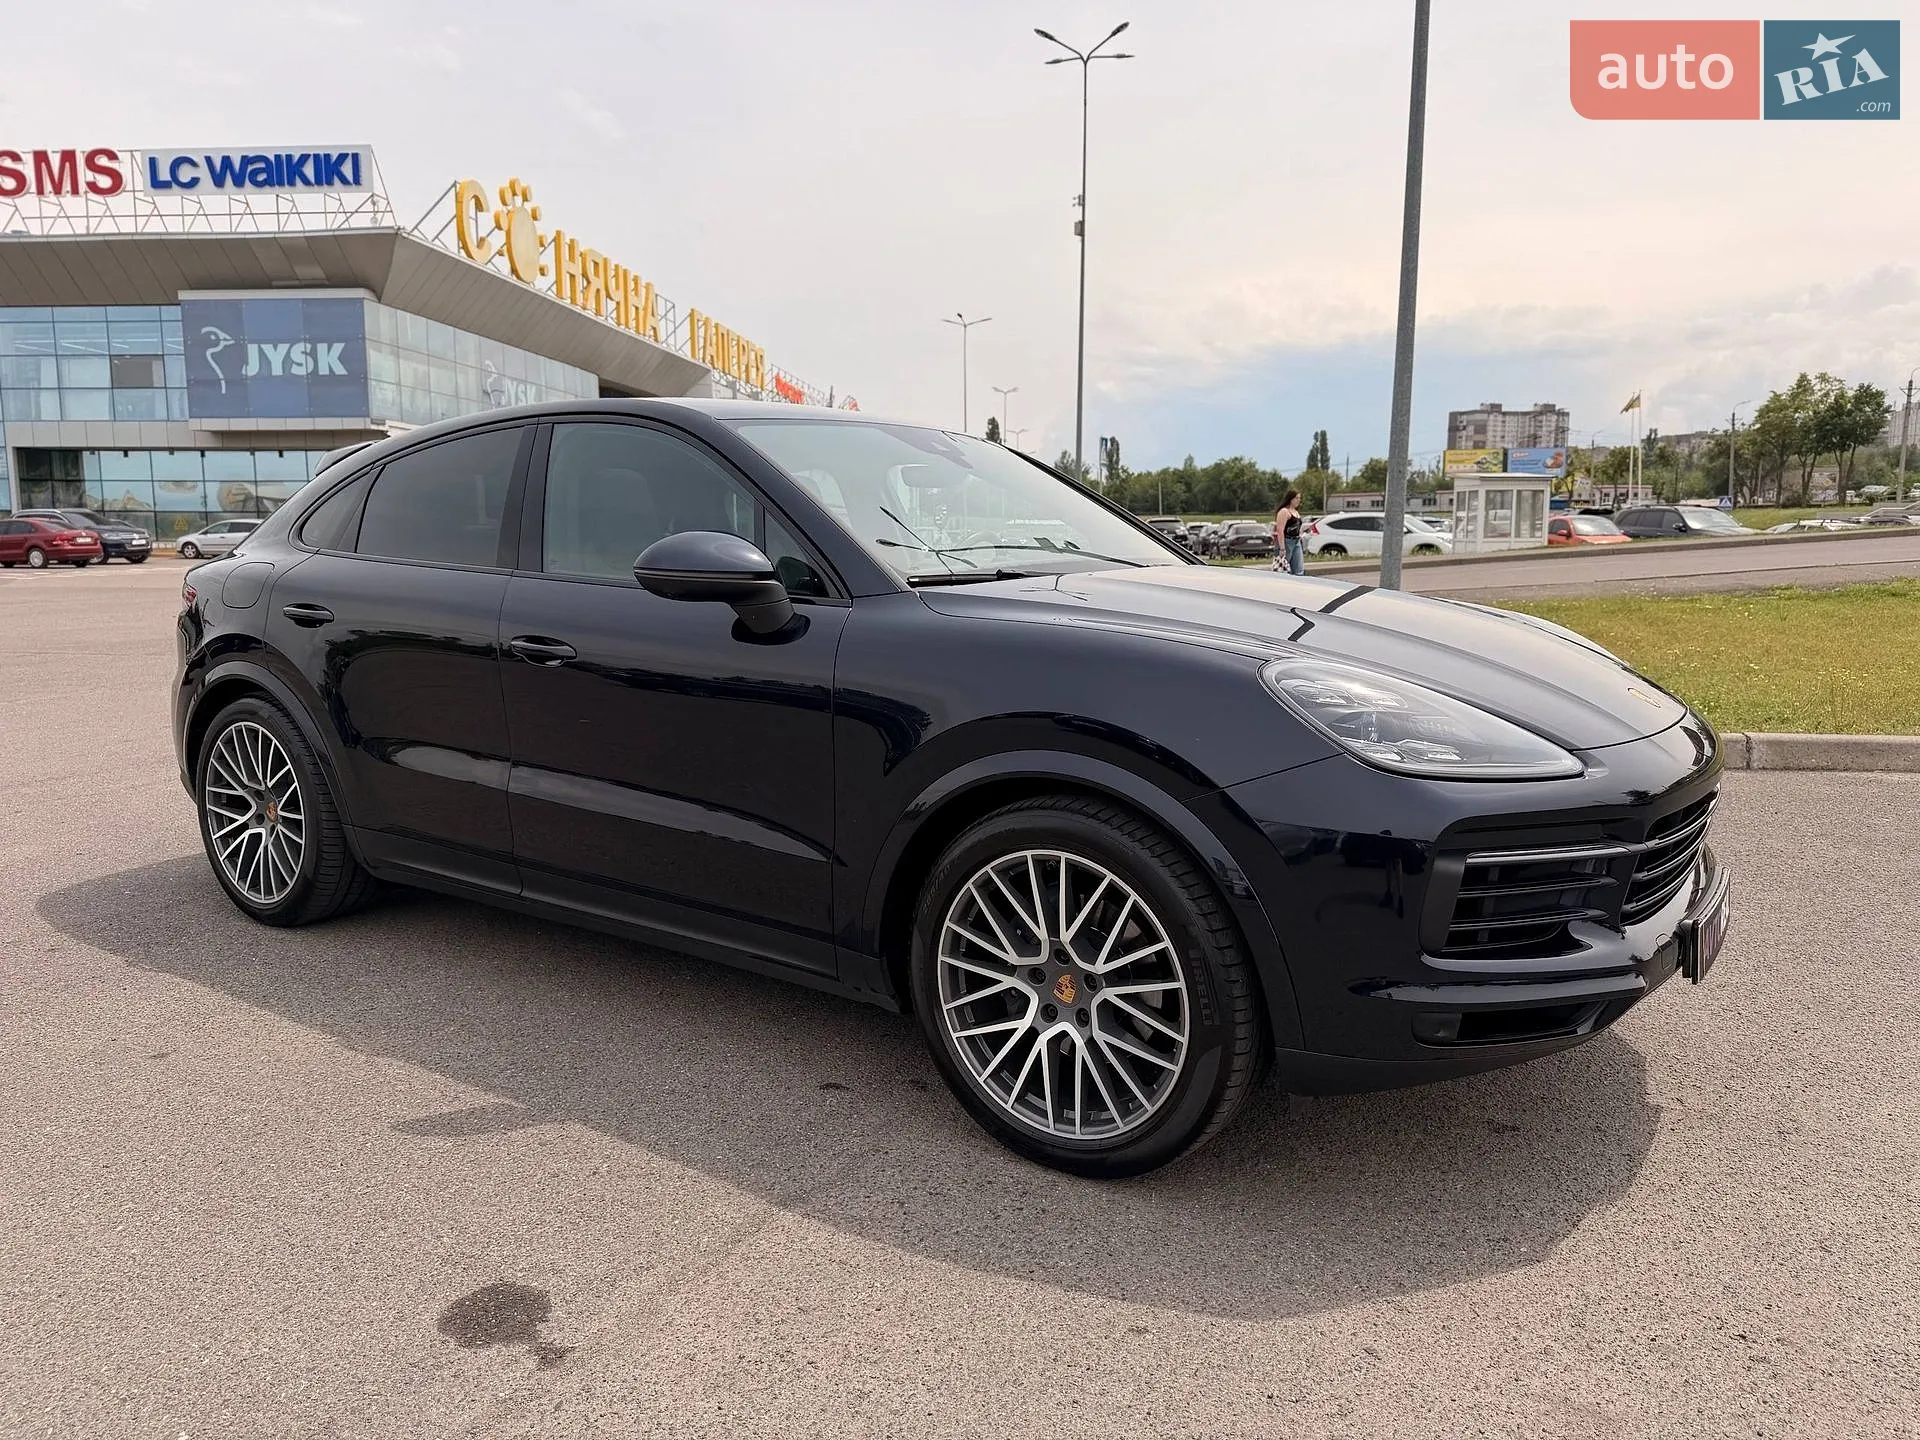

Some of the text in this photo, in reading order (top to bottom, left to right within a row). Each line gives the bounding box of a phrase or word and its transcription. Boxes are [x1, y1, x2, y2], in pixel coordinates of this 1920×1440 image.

[0, 147, 125, 198] SMS
[148, 155, 200, 189] LC
[241, 341, 349, 377] JYSK
[689, 307, 765, 391] ГАЛЕРЕЯ
